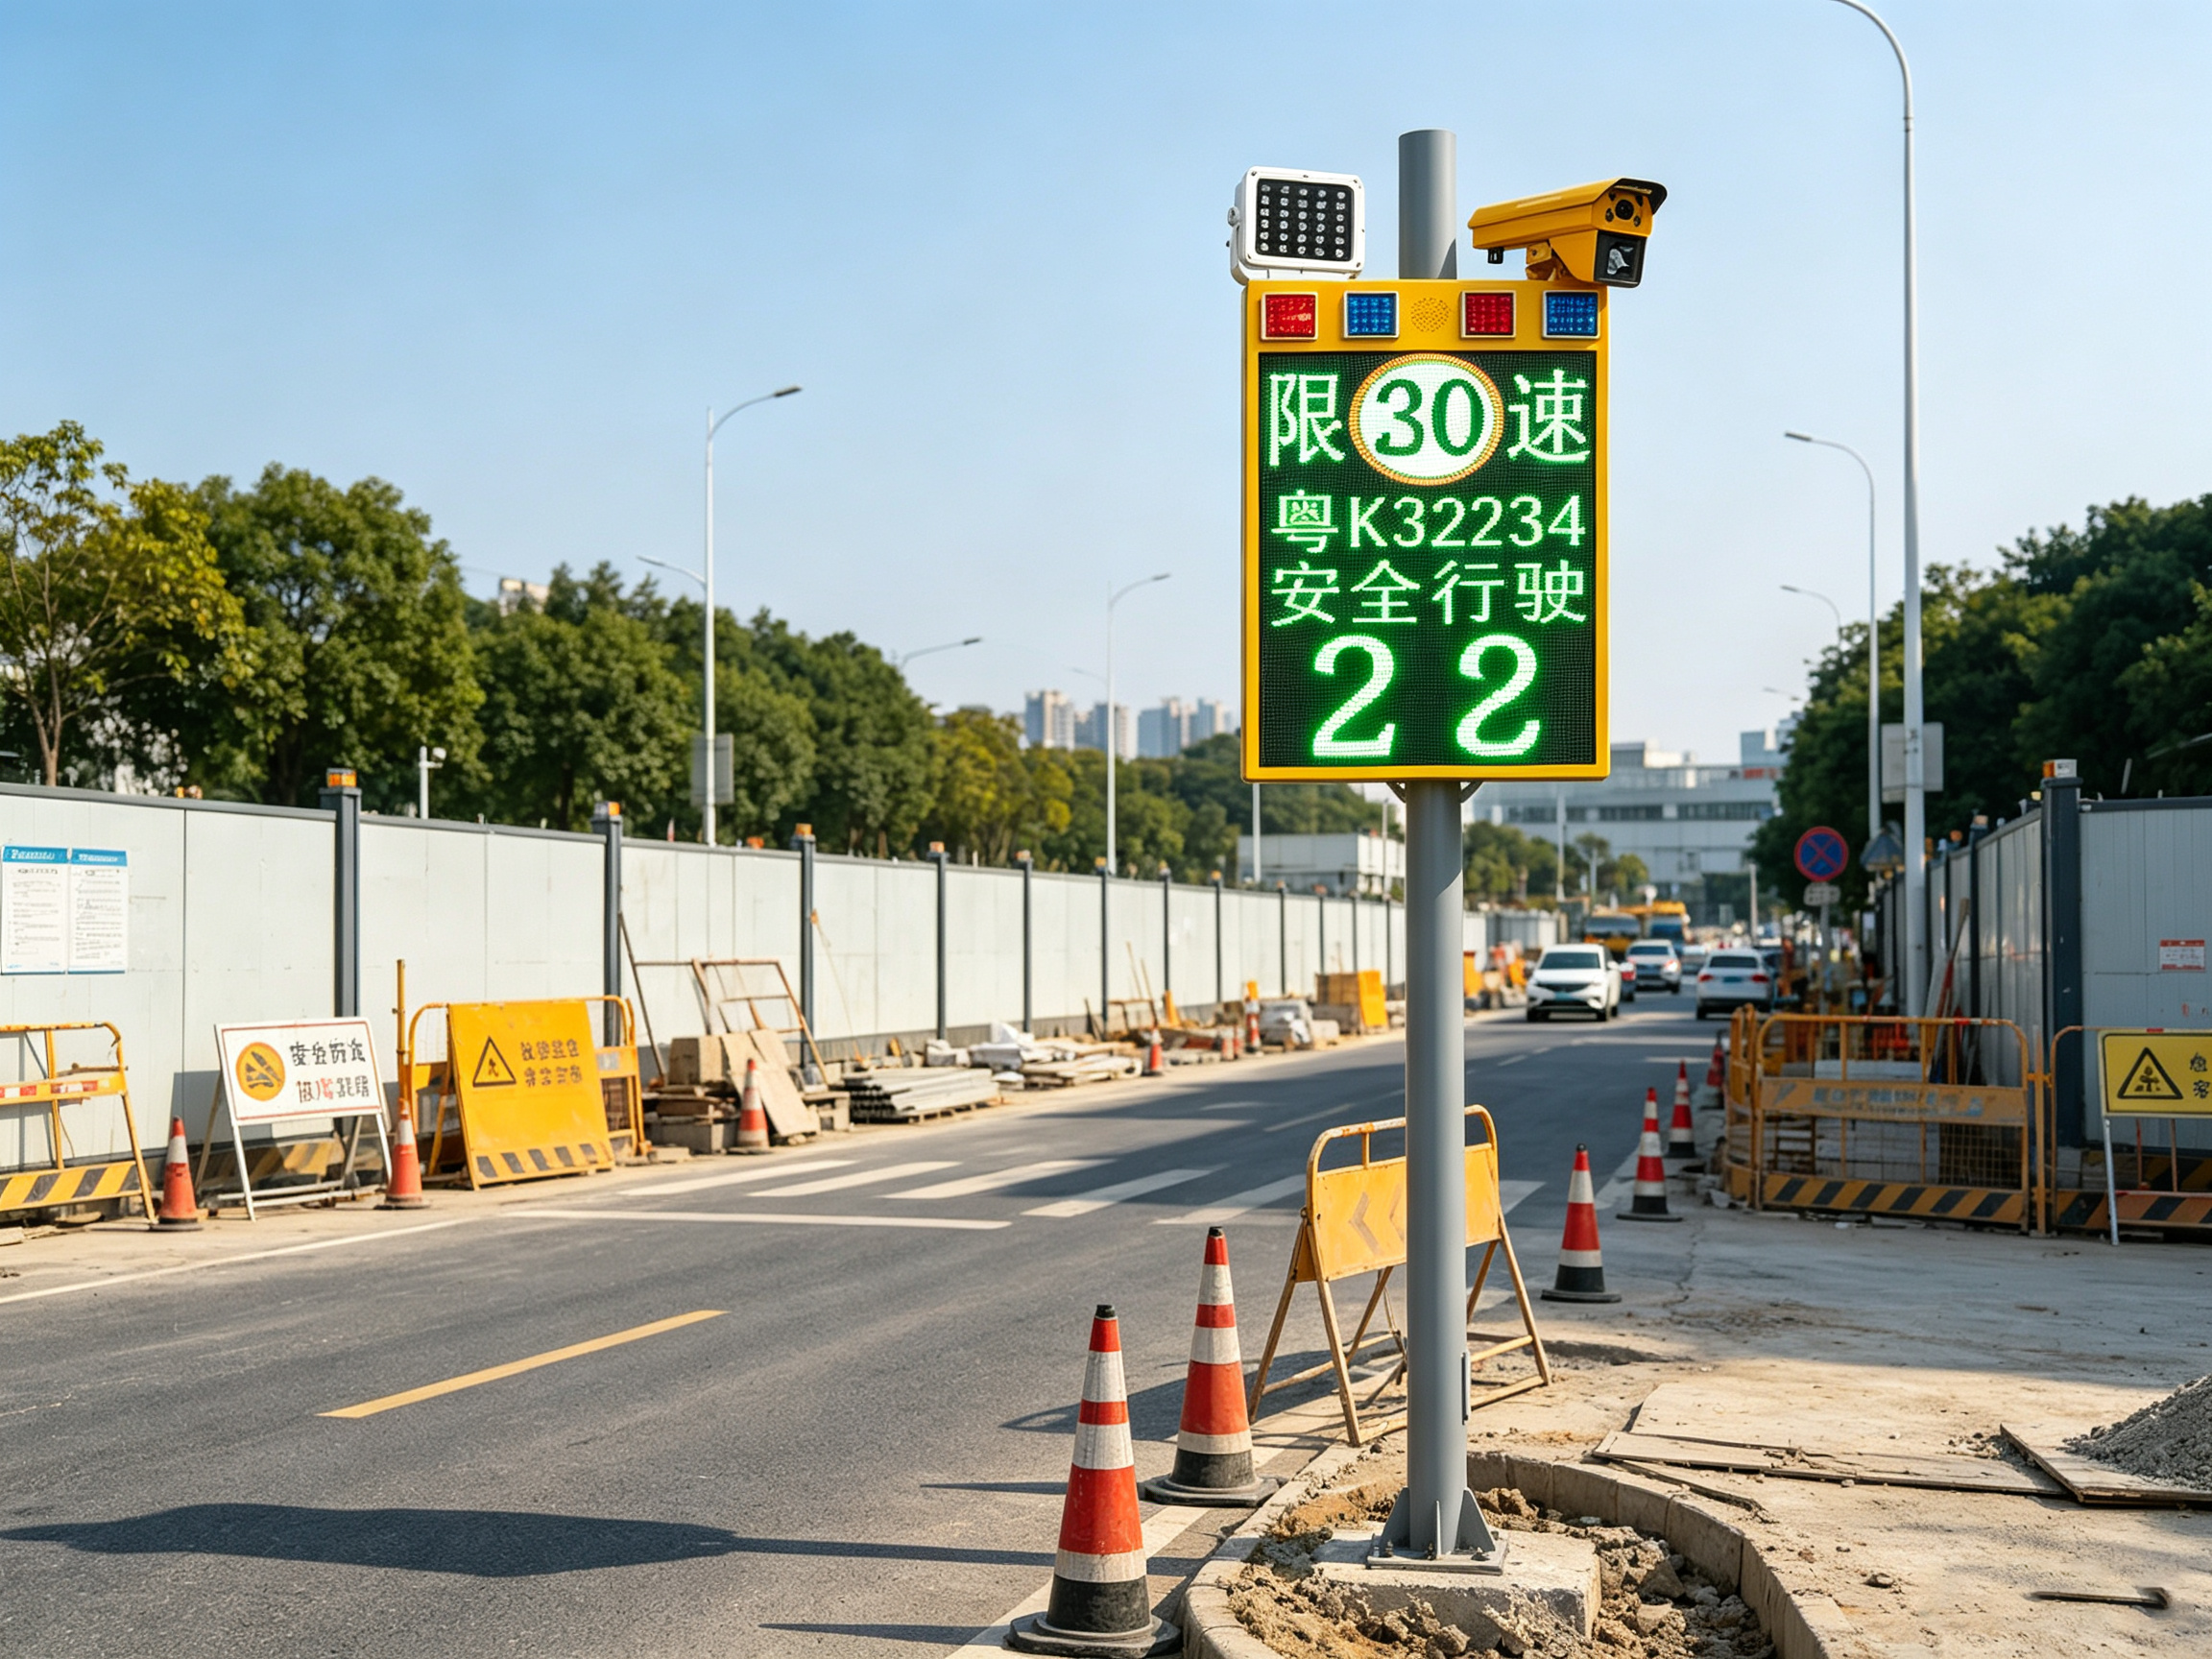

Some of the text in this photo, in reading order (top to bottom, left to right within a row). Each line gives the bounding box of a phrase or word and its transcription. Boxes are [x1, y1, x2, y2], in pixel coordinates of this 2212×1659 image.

[1269, 369, 1591, 466] 限 30 速
[1271, 560, 1587, 626] 安全行驶
